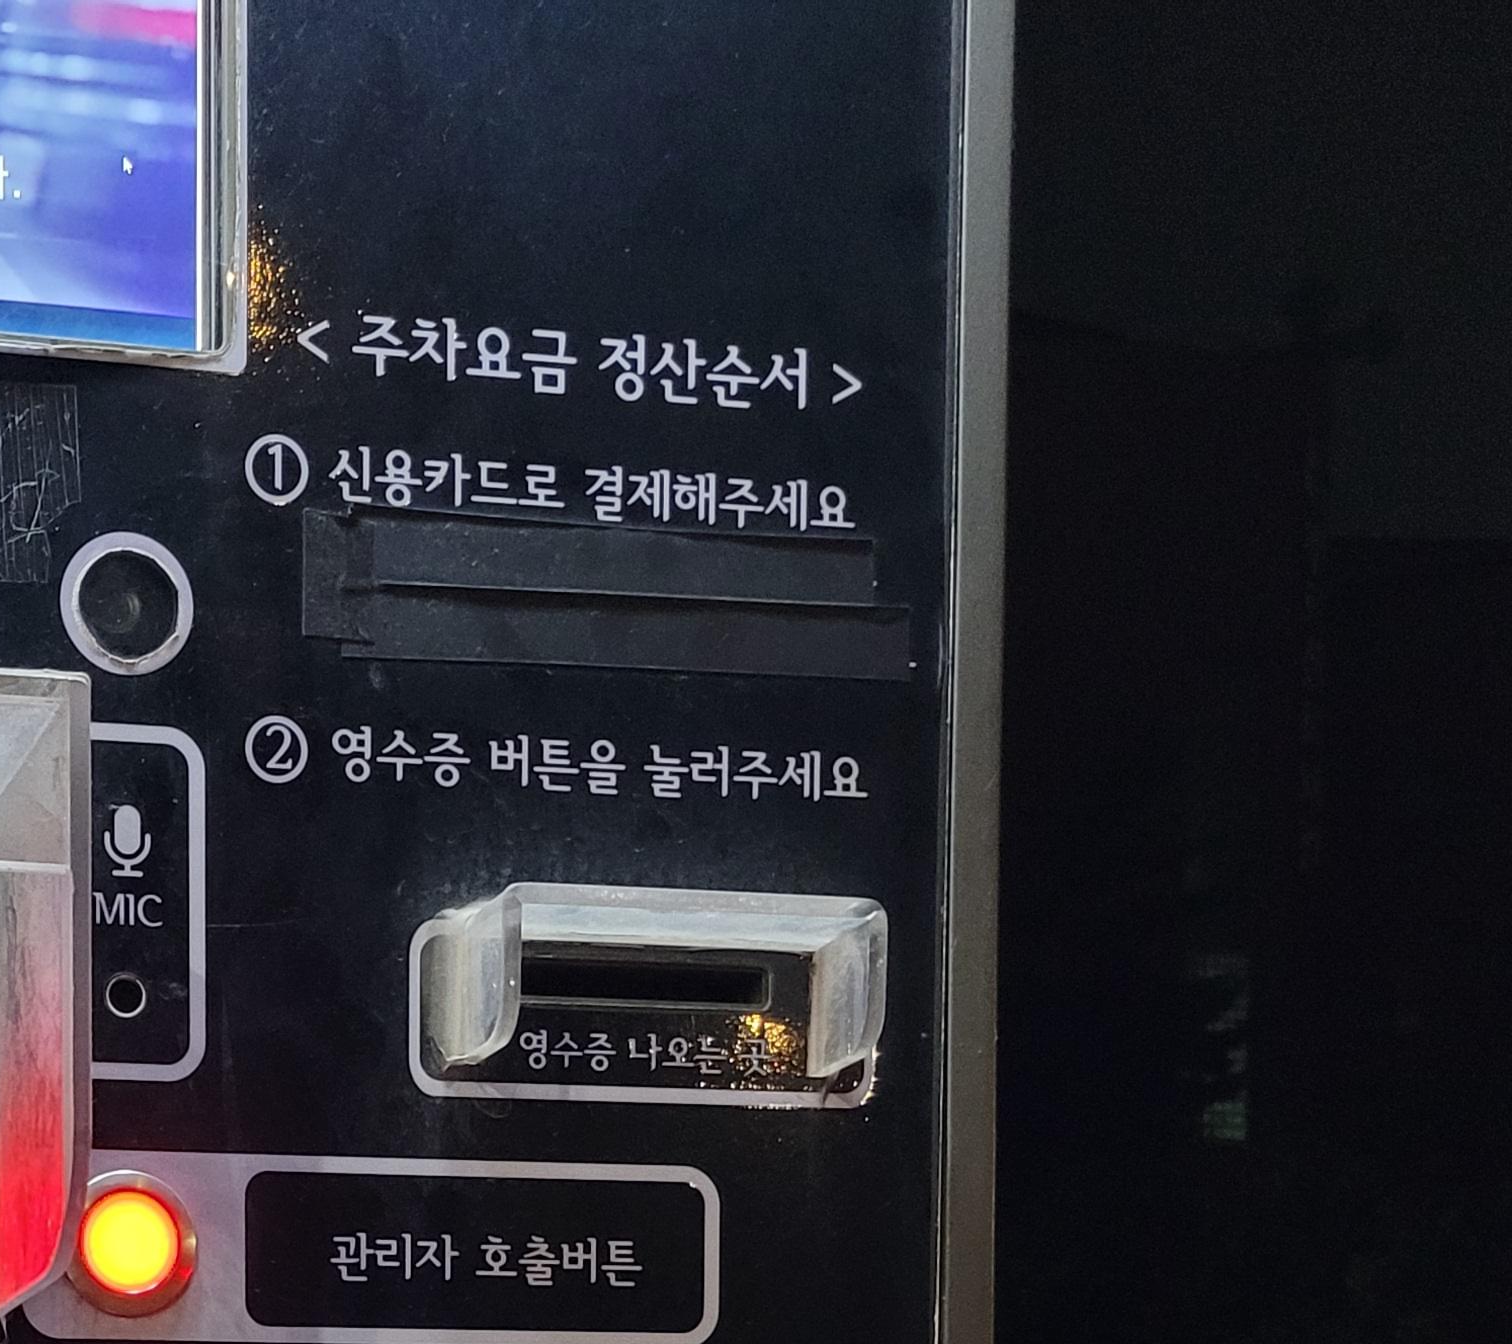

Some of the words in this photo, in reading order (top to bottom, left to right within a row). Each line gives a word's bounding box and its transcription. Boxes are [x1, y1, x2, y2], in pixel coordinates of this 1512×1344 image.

[352, 314, 577, 395] 주차요금
[598, 333, 808, 409] 정산순서
[328, 446, 565, 509] 신용카드로
[585, 465, 856, 531] 결제해주세요
[332, 725, 470, 788] 영수증
[489, 735, 626, 796] 버튼을
[644, 744, 868, 801] 눌러주세요
[92, 893, 163, 928] MIC
[518, 1032, 616, 1072] 영수증
[330, 1234, 459, 1283] 관리자
[475, 1236, 644, 1287] 호출버튼
